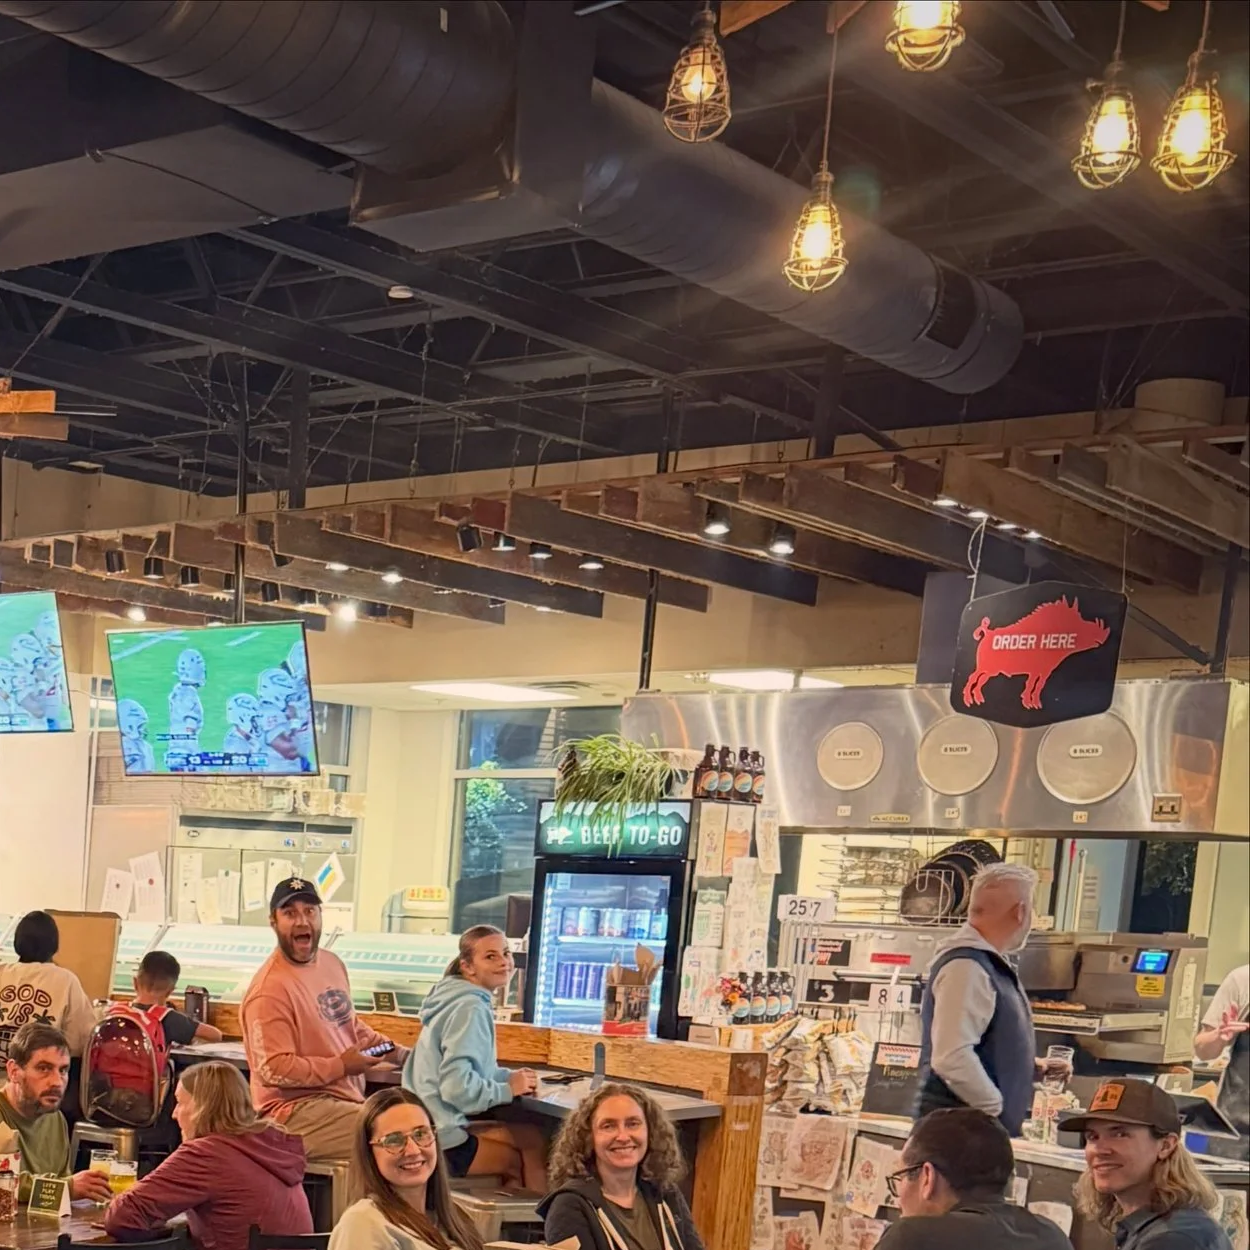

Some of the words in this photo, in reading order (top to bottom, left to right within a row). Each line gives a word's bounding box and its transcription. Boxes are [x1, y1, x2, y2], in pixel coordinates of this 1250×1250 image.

[992, 634, 1037, 650] ORDER
[1040, 633, 1077, 649] HERE
[231, 754, 247, 765] 20
[629, 825, 682, 845] TO-GO
[7, 1003, 35, 1026] IS
